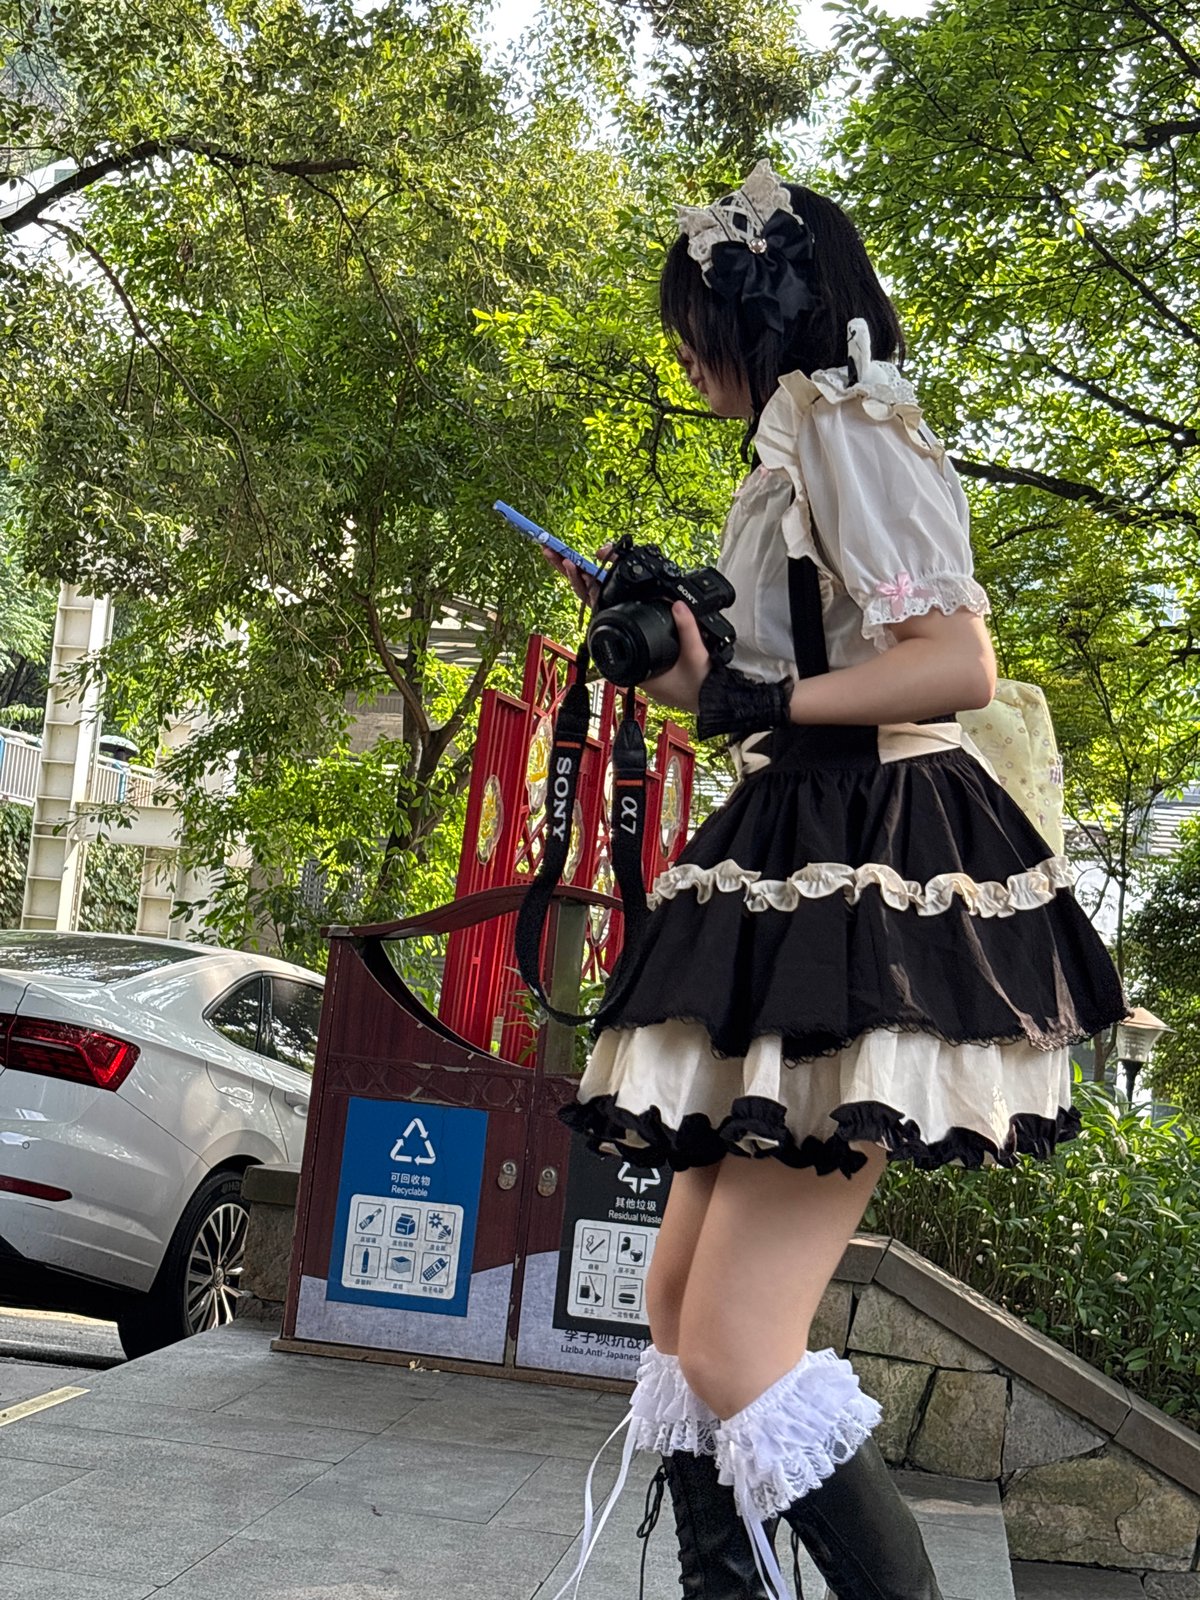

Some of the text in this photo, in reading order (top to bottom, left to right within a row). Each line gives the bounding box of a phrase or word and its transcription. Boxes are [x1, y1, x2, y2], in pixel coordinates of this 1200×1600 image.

[677, 584, 698, 605] SONY
[552, 757, 572, 842] SONY
[391, 1172, 431, 1186] 可回收物
[391, 1185, 428, 1197] Recyclable
[615, 1197, 657, 1212] 其他垃圾
[608, 1210, 662, 1224] Residual Waste
[564, 1329, 647, 1351] 李子坝抗战
[561, 1345, 584, 1355] Liziba
